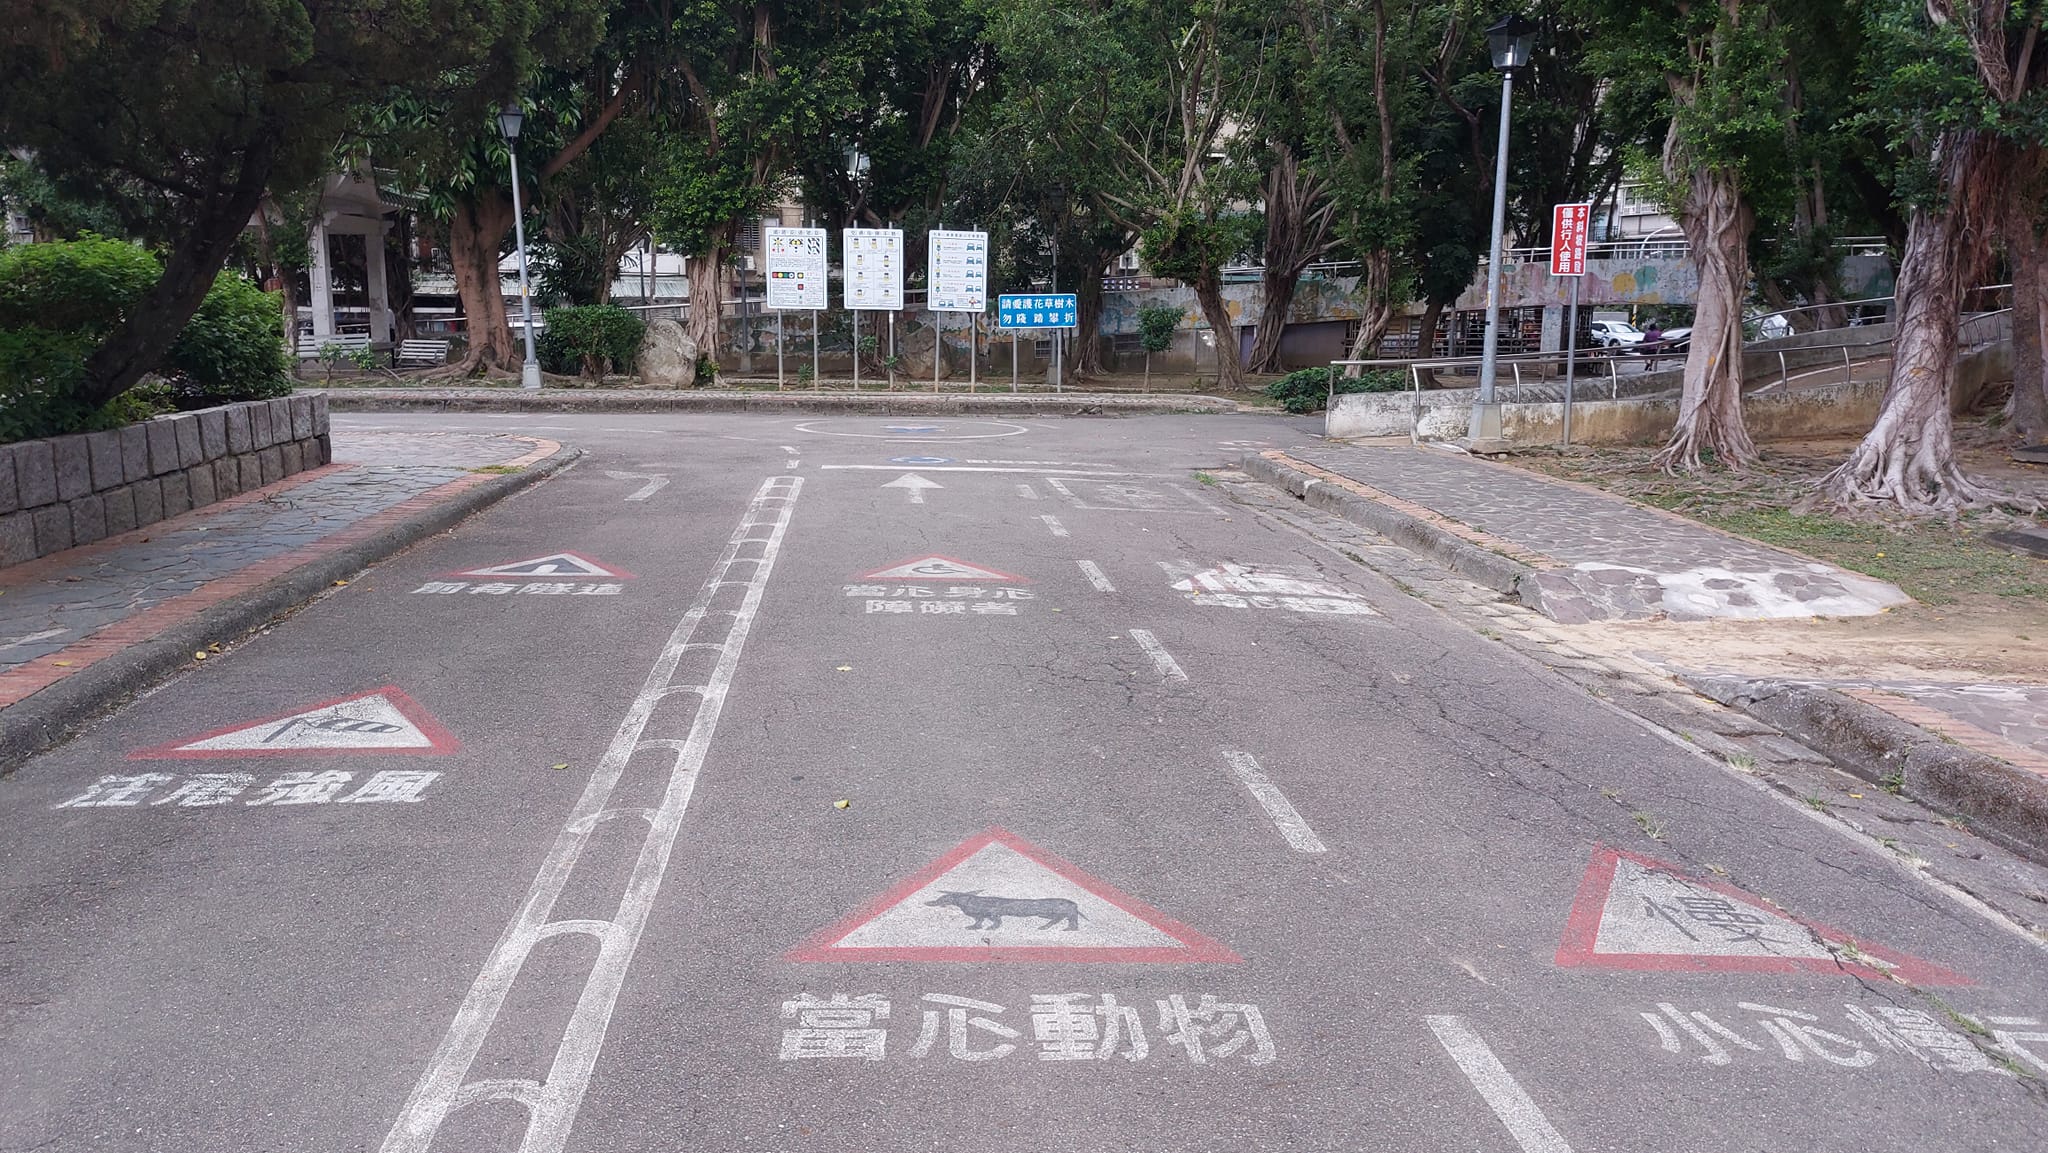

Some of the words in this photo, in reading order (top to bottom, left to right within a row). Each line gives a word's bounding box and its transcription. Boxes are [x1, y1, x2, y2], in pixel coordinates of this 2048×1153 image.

[1559, 207, 1574, 273] 僅供行人使用
[1001, 298, 1074, 310] 請愛護花草樹木
[1002, 312, 1074, 324] 勿踐踏攀折
[841, 584, 1035, 600] 當心身心
[865, 600, 1018, 615] 障礙者
[54, 769, 443, 809] 注意強風
[779, 993, 1278, 1066] 當心動物
